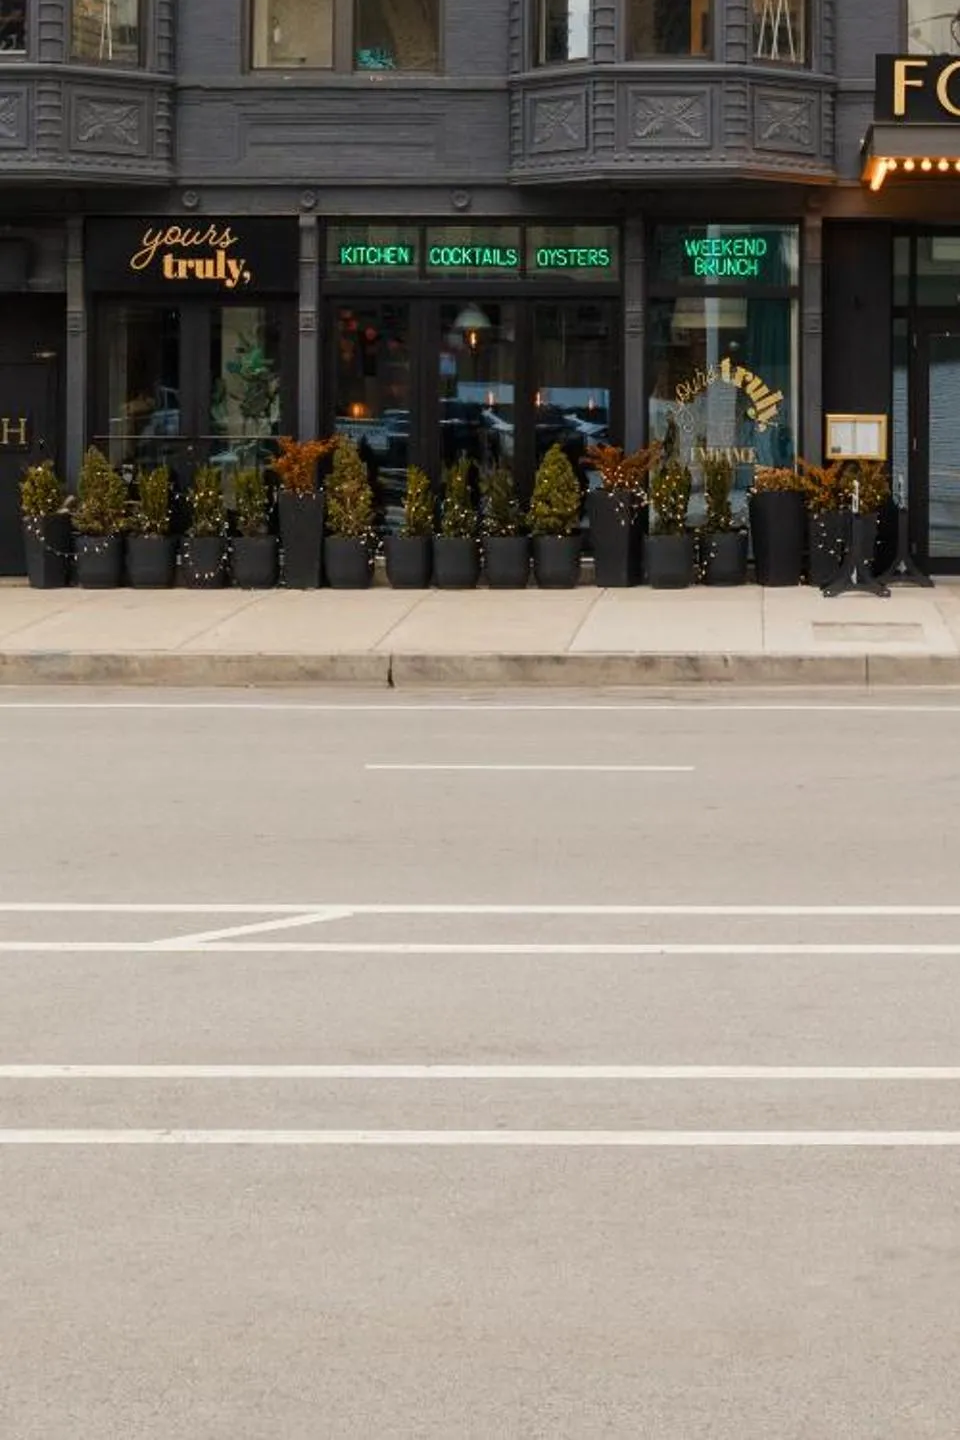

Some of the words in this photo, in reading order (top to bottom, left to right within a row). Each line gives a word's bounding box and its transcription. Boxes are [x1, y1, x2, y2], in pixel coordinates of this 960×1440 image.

[130, 224, 238, 269] yours
[341, 247, 409, 265] KITCHEN
[684, 238, 767, 256] WEEKEND
[429, 247, 518, 266] COCKTAILS
[536, 249, 609, 266] OYSTERS
[163, 249, 251, 288] truly,
[694, 257, 759, 276] BRUNCH
